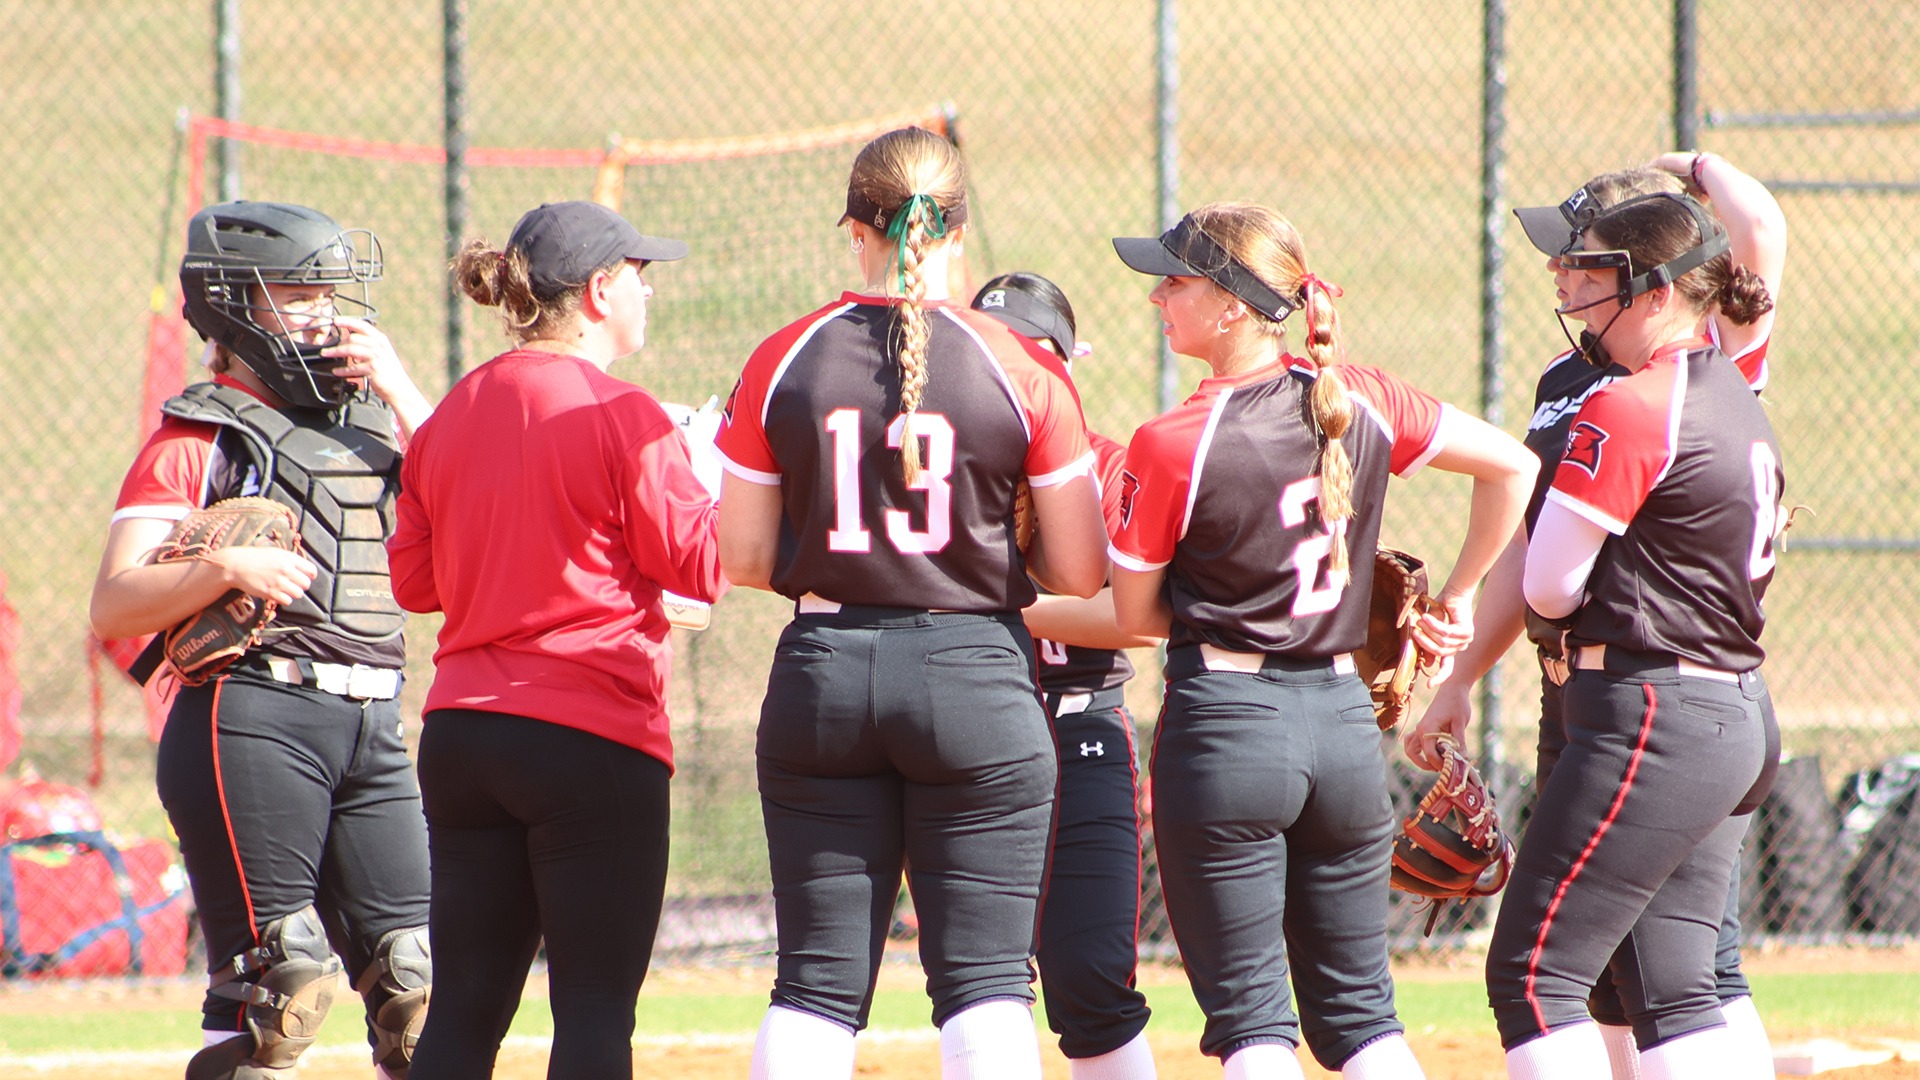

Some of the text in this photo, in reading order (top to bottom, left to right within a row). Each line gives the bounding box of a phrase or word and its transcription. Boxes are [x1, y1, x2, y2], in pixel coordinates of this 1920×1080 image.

[825, 407, 957, 555] 13
[1278, 474, 1350, 619] 2
[176, 628, 220, 661] Wilson
